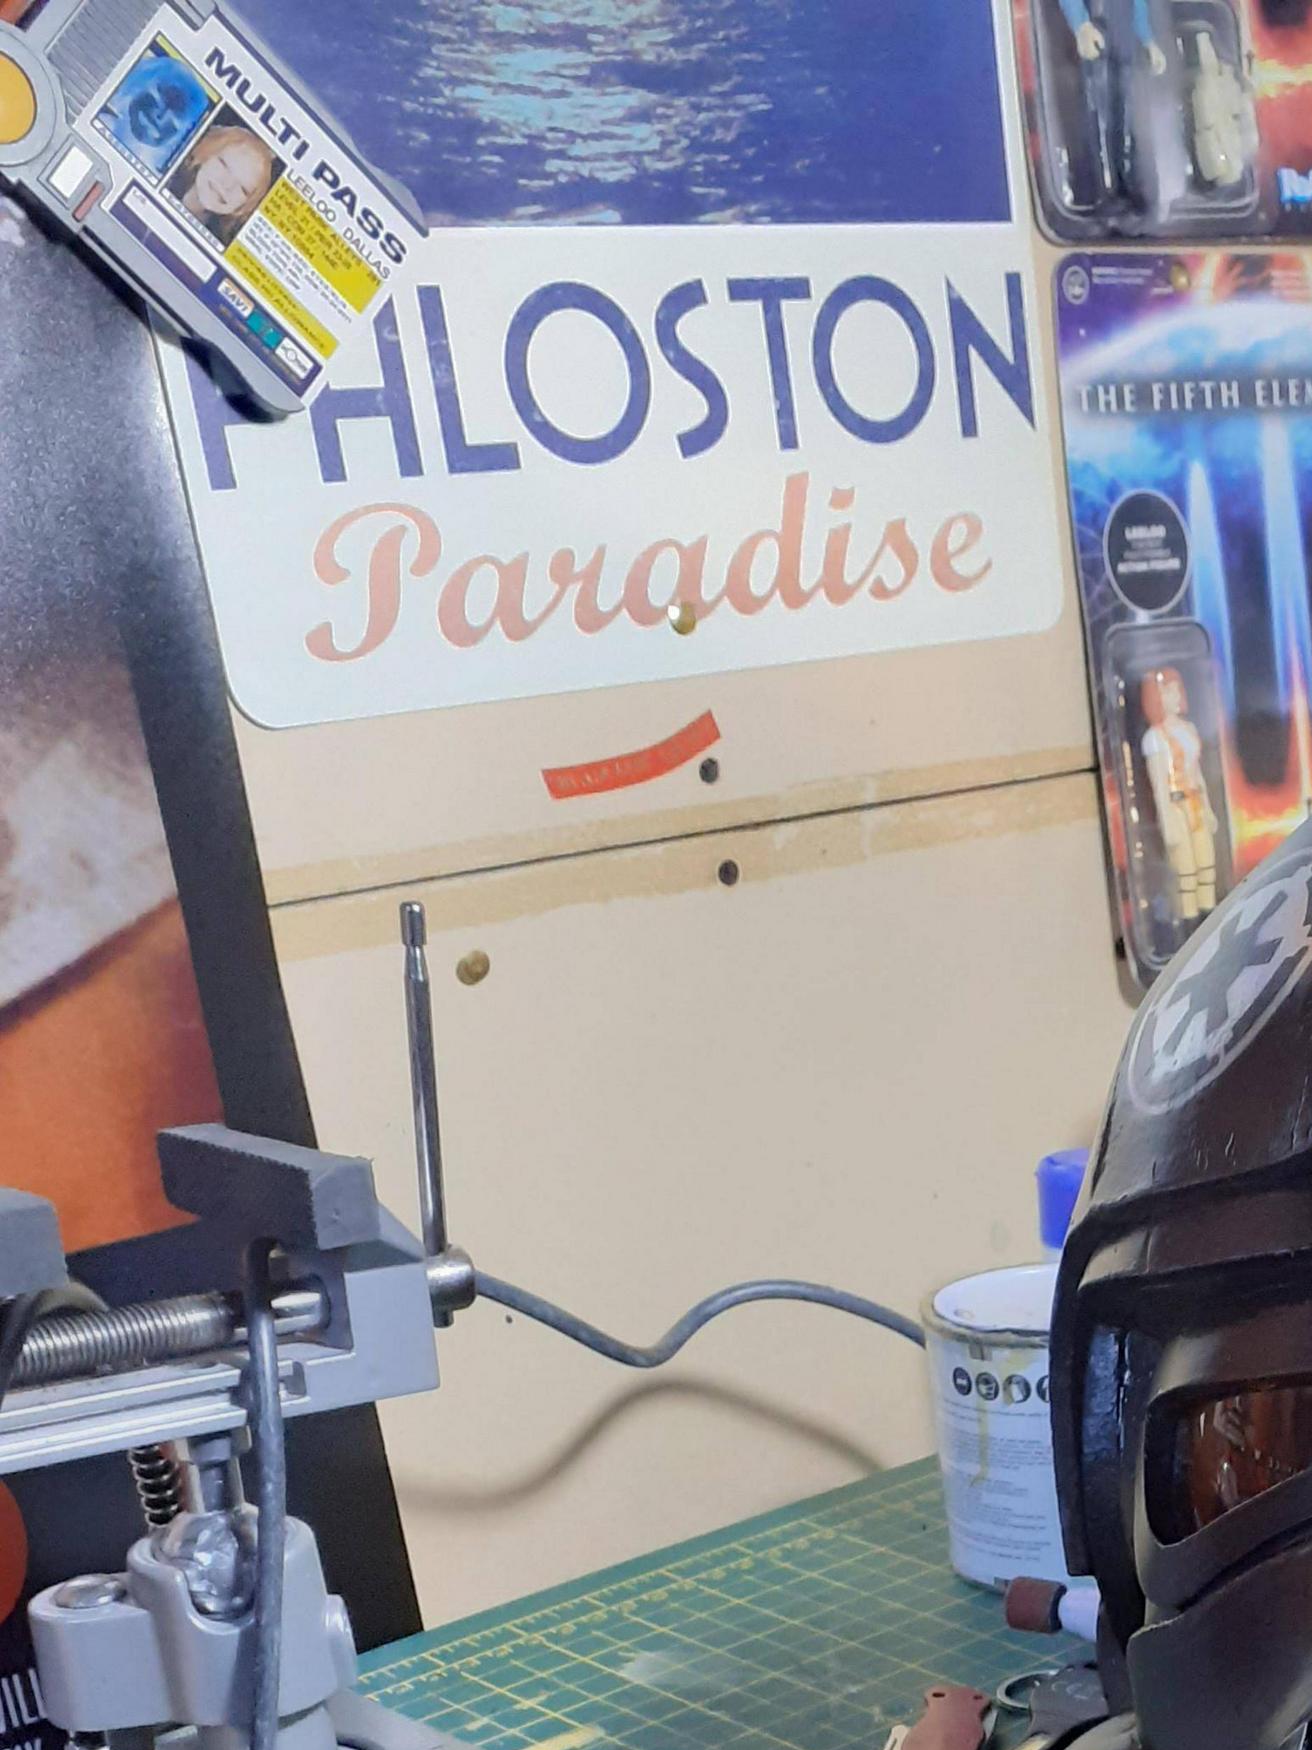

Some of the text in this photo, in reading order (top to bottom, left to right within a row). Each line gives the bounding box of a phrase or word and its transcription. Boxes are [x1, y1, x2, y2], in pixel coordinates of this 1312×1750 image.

[204, 46, 309, 164] MULTI
[312, 158, 408, 266] PASS
[285, 168, 338, 224] LEELOO
[341, 226, 391, 281] DALLAS
[1077, 381, 1137, 414] THE
[1151, 378, 1240, 411] FIFTH
[306, 472, 993, 662] Paradise
